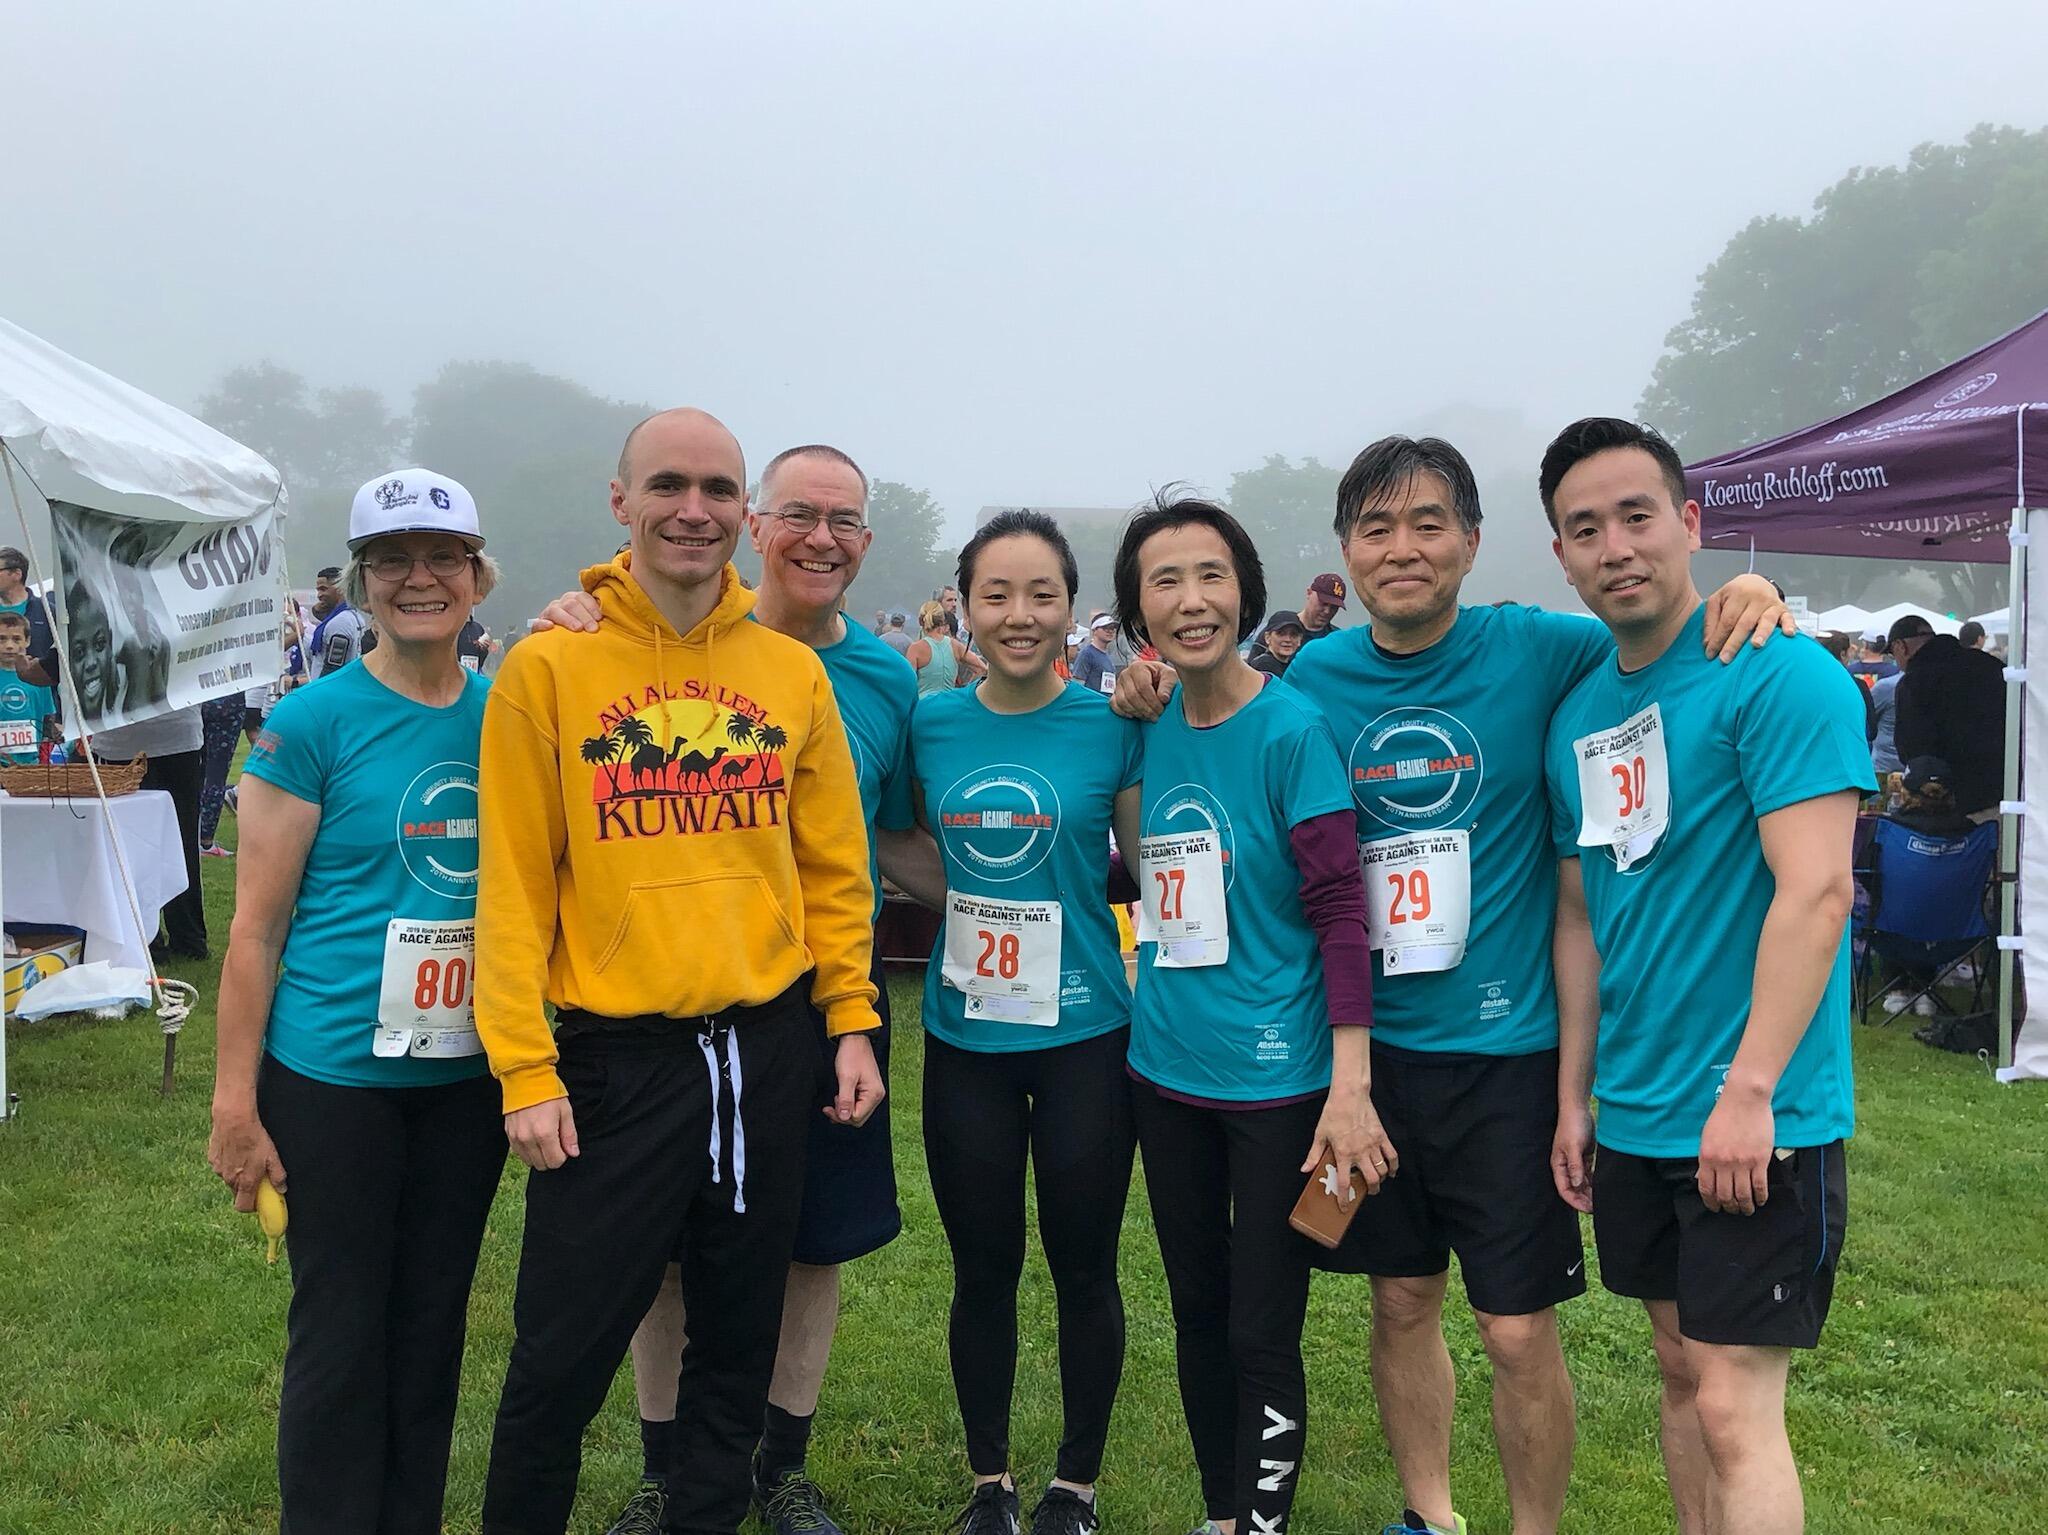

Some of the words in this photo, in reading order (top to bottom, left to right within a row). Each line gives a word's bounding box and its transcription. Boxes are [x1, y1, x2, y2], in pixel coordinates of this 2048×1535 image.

[1703, 462, 1889, 510] KoenigRubloff.com
[600, 694, 639, 733] ALI
[643, 681, 677, 706] AL
[684, 680, 769, 725] SALEM
[1584, 744, 1606, 760] RACE
[1609, 729, 1640, 752] AGAINST
[1641, 718, 1658, 736] HATE
[1354, 764, 1396, 781] RACE
[1395, 757, 1430, 780] AGAINST
[1428, 754, 1475, 772] HATE
[1612, 757, 1646, 817] 30
[404, 822, 446, 837] RACE
[446, 819, 478, 839] AGAINST
[595, 788, 788, 842] KUWAIT
[943, 813, 981, 826] RACE
[981, 810, 1013, 829] AGAINST
[1012, 813, 1053, 828] HATE
[1151, 846, 1182, 859] AGAINST
[1186, 843, 1212, 854] HATE
[1363, 851, 1384, 866] RACE
[1386, 844, 1427, 861] AGAINST
[1430, 842, 1460, 854] HATE
[953, 903, 977, 916] RACE
[978, 909, 1022, 922] AGAINST
[1024, 913, 1052, 923] HATE
[1156, 870, 1185, 921] 27
[1388, 870, 1433, 926] 29
[399, 933, 432, 944] RACE
[434, 931, 475, 944] AGAINS
[976, 930, 1020, 980] 28
